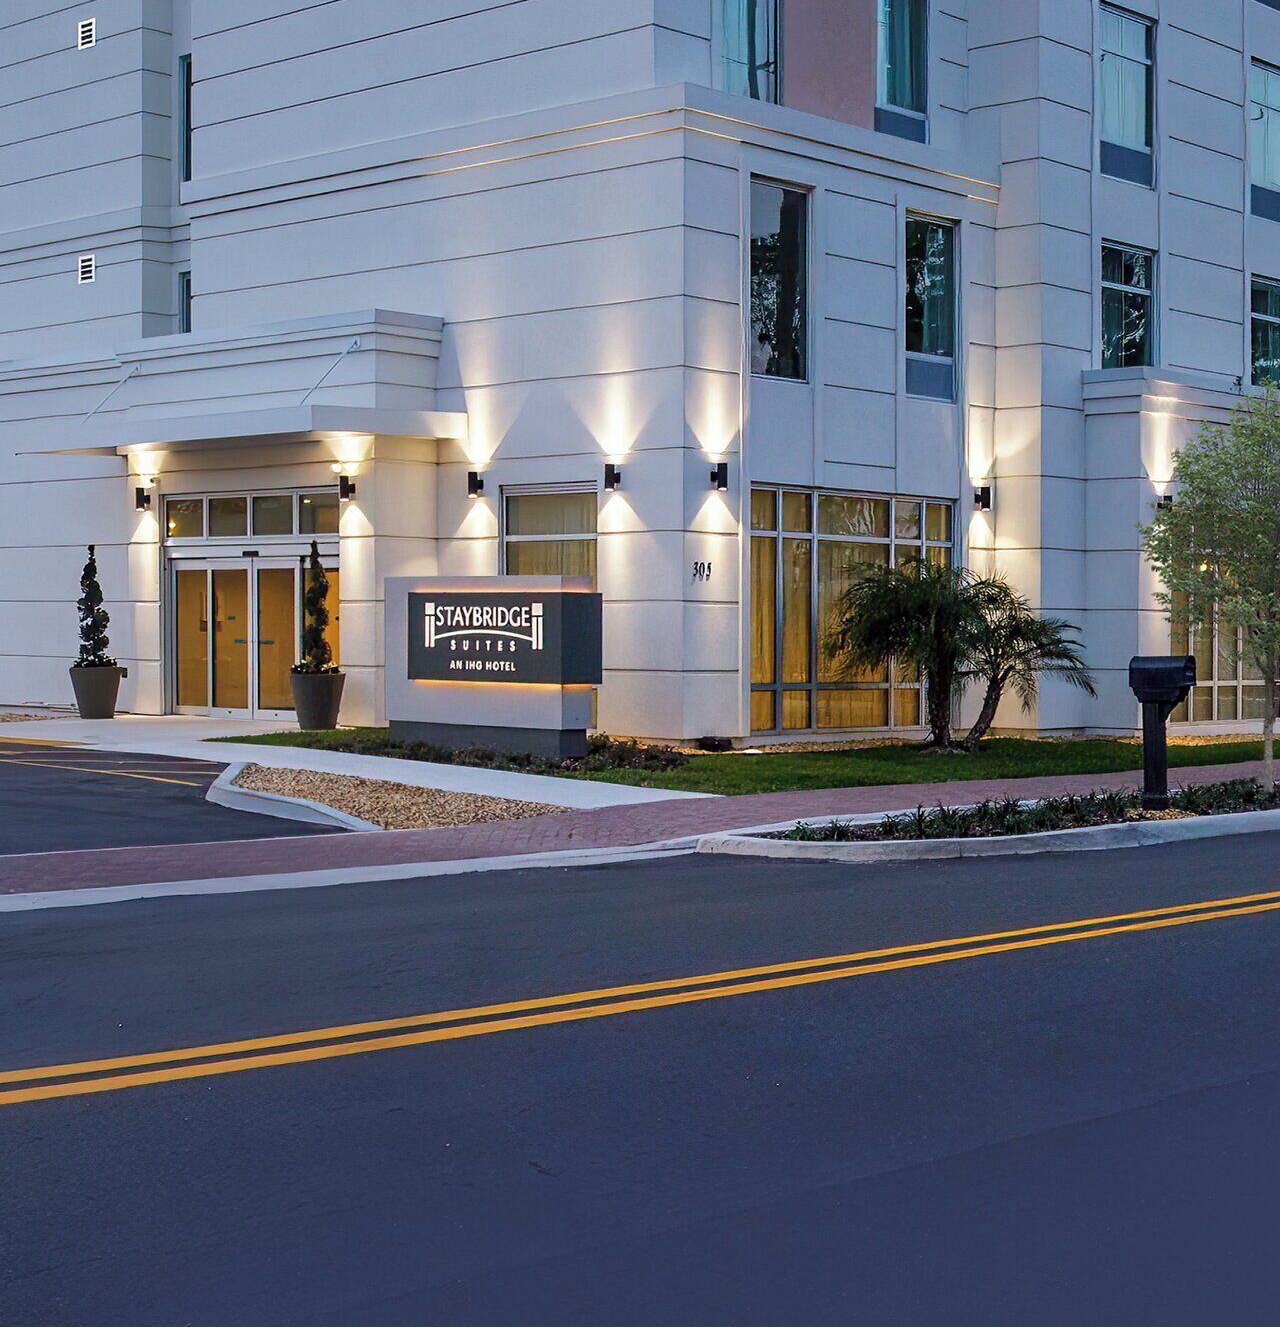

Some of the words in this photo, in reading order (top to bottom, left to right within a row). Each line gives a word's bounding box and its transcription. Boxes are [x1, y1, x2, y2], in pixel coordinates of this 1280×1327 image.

[436, 606, 531, 627] STAYBRIDGE
[450, 639, 516, 652] SUITES
[449, 660, 463, 670] AN
[465, 660, 483, 671] IHG
[485, 661, 516, 672] HOTEL
